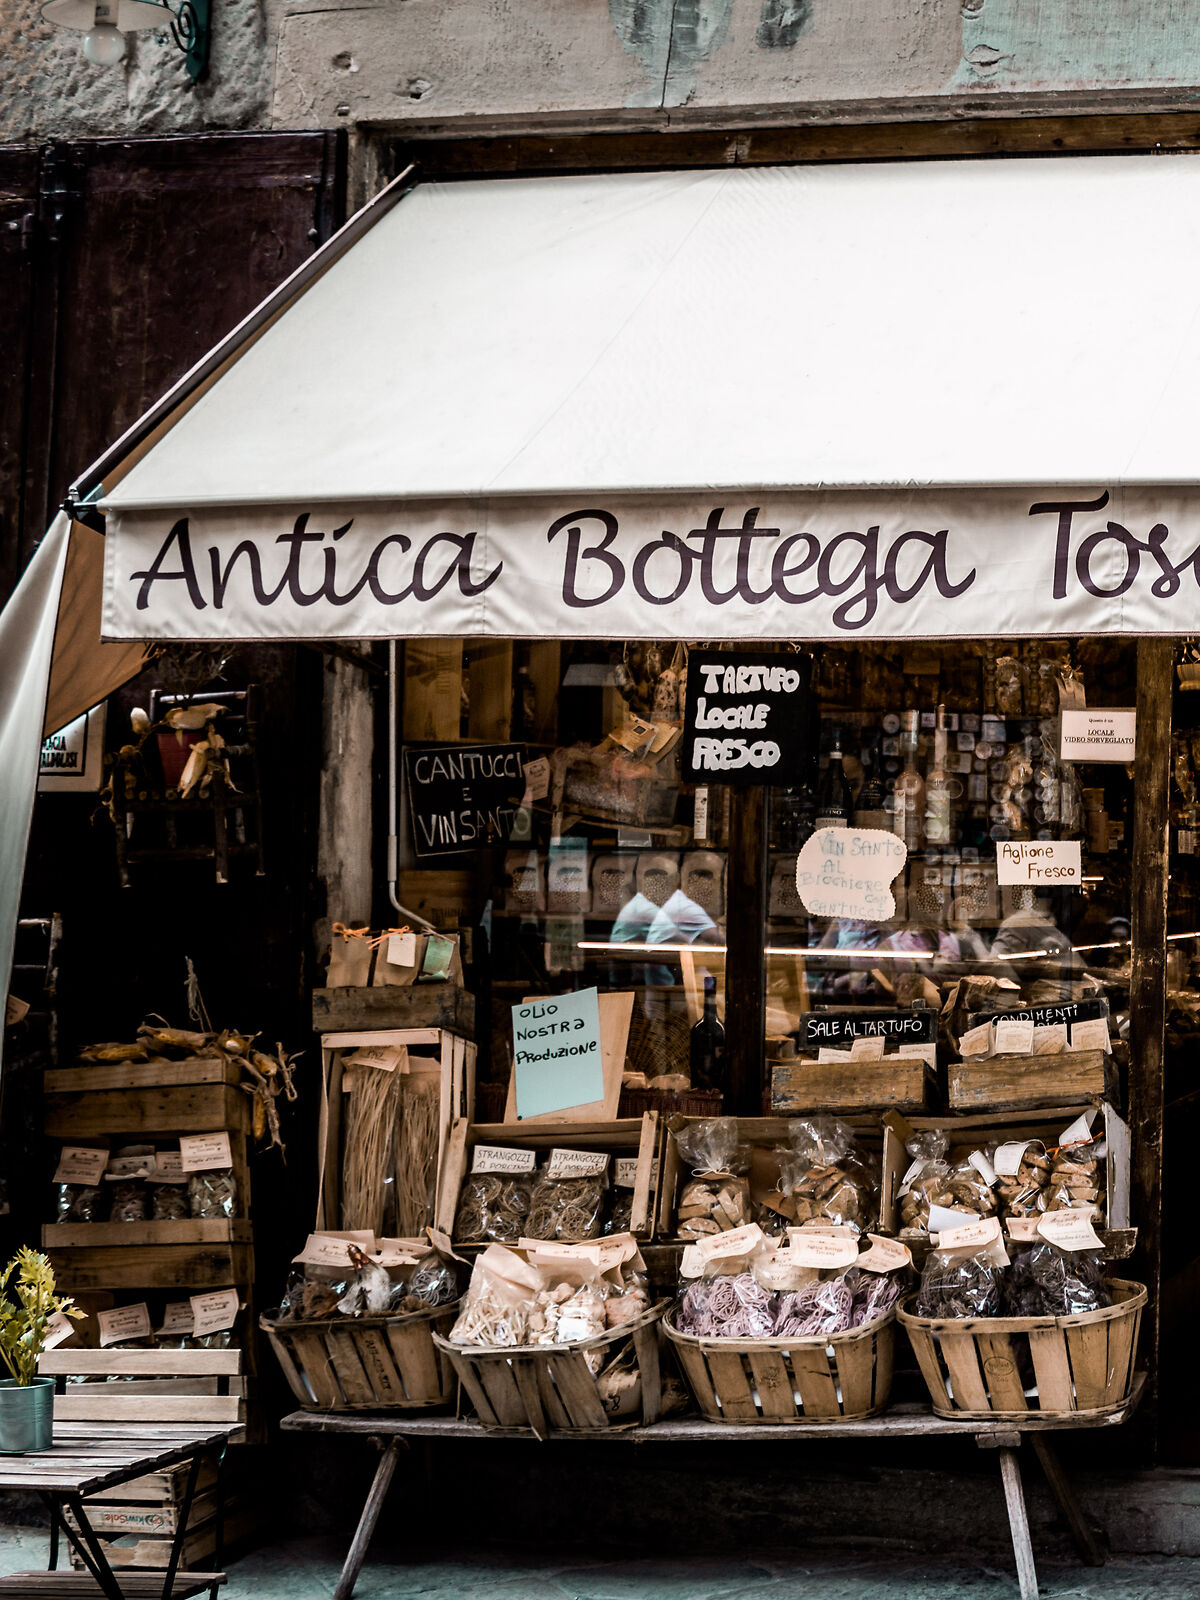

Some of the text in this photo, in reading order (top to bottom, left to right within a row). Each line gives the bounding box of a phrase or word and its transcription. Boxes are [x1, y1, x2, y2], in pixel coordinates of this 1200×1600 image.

[130, 511, 504, 611] Antica
[547, 507, 977, 631] Bottega
[699, 663, 800, 695] TARTUFO
[694, 697, 769, 730] LOCALE
[692, 736, 781, 770] FRESCO
[1086, 737, 1135, 745] SORVEGLIATO
[415, 752, 523, 784] CANTUCCI
[462, 787, 472, 801] E
[1003, 843, 1054, 865] Aglione
[1028, 862, 1075, 879] Fresco
[808, 1019, 840, 1038] SALE
[861, 1019, 923, 1035] TARTUFO
